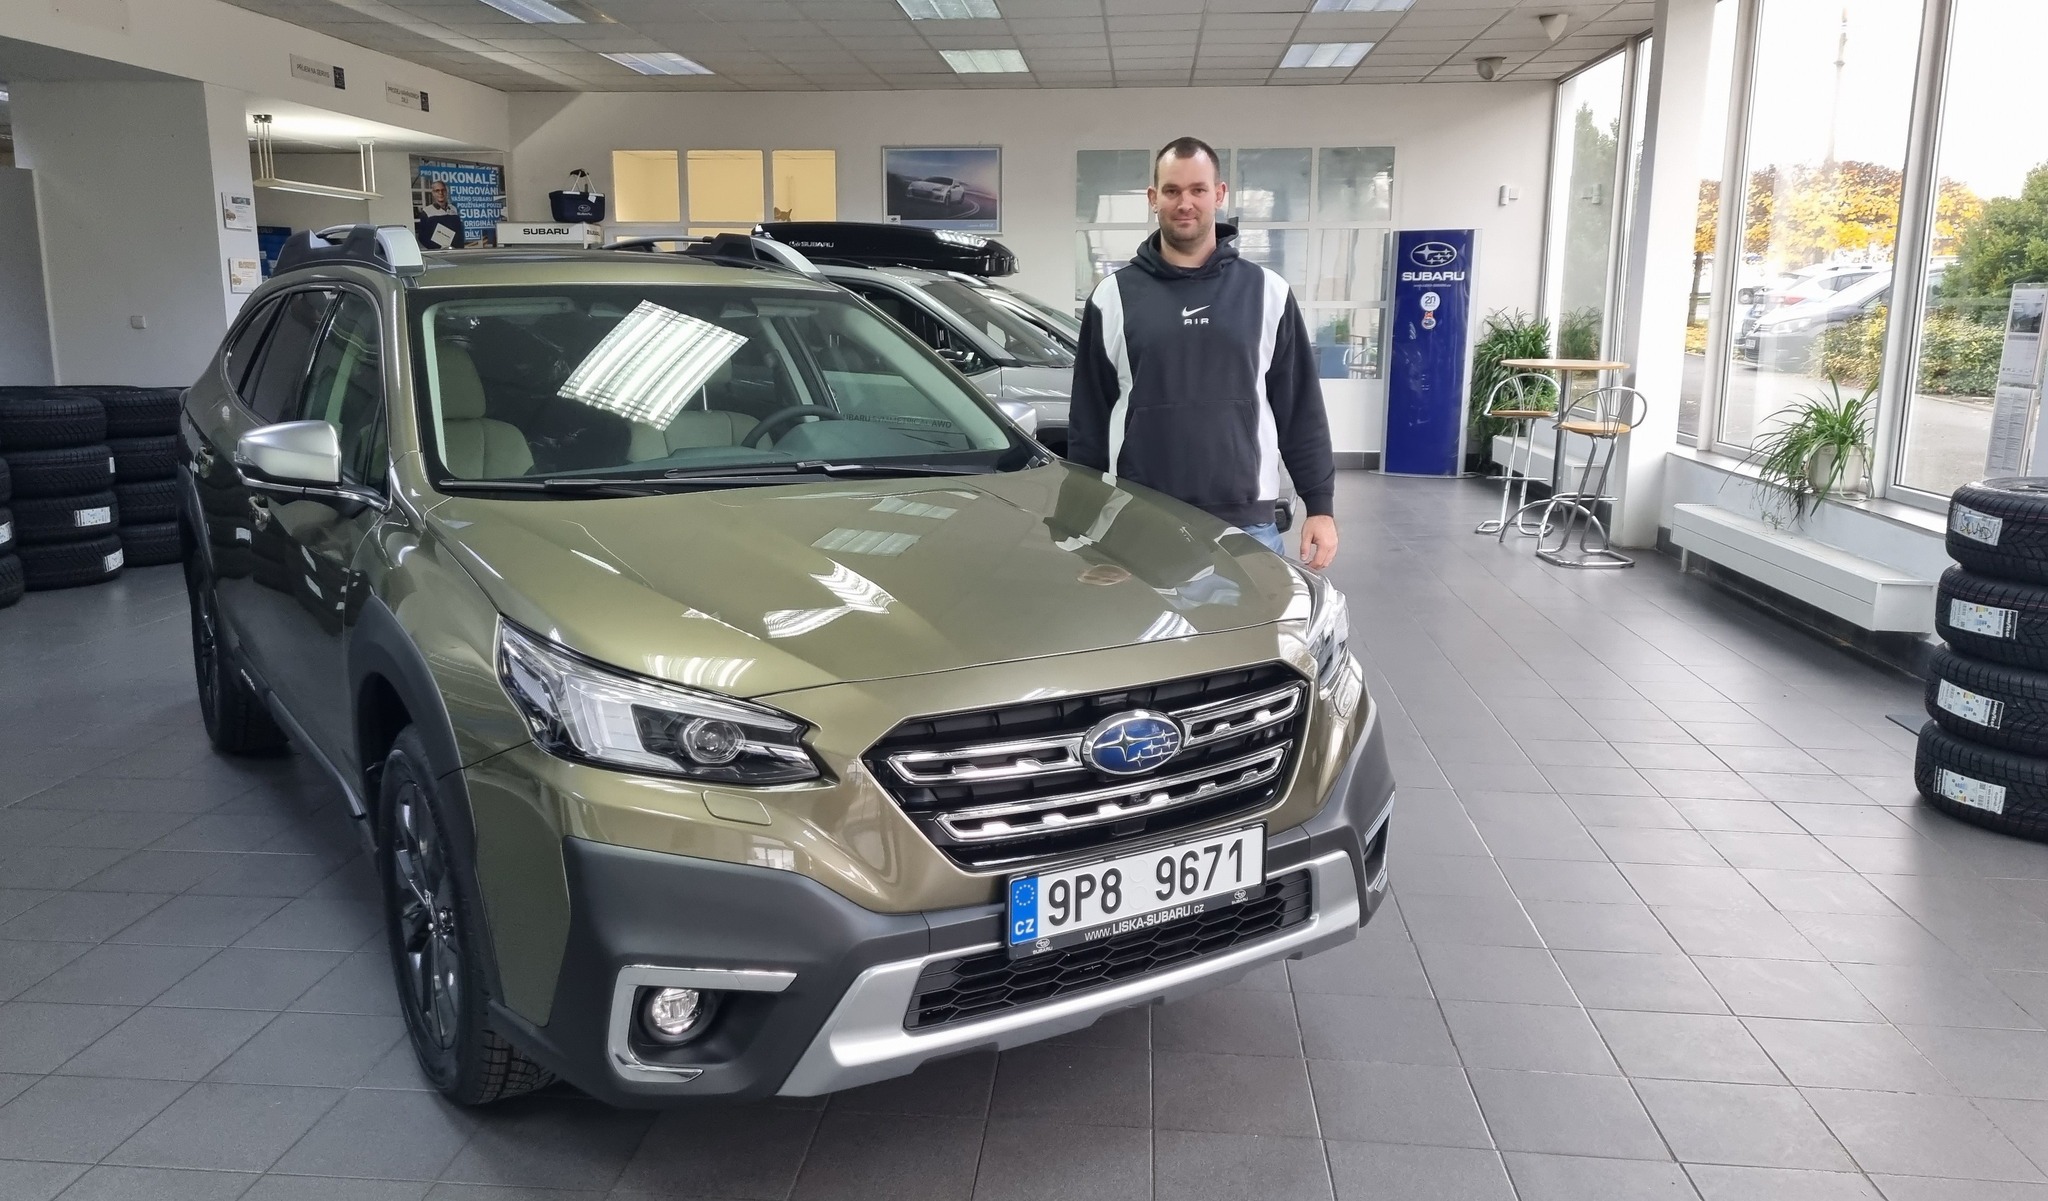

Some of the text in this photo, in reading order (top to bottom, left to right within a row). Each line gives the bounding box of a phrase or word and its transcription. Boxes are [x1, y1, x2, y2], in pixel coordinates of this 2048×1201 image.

[432, 170, 497, 185] DOKONALÉ
[450, 184, 499, 196] FUNGOVÁNÍ
[460, 208, 500, 219] SUBARU
[1402, 271, 1465, 281] SUBARU
[931, 421, 953, 429] AWD
[1048, 838, 1244, 927] 9P8 9671
[1015, 919, 1034, 936] CZ
[1084, 903, 1205, 942] www.LISKA-SUBARU.cz
[1032, 943, 1054, 954] SUBARU
